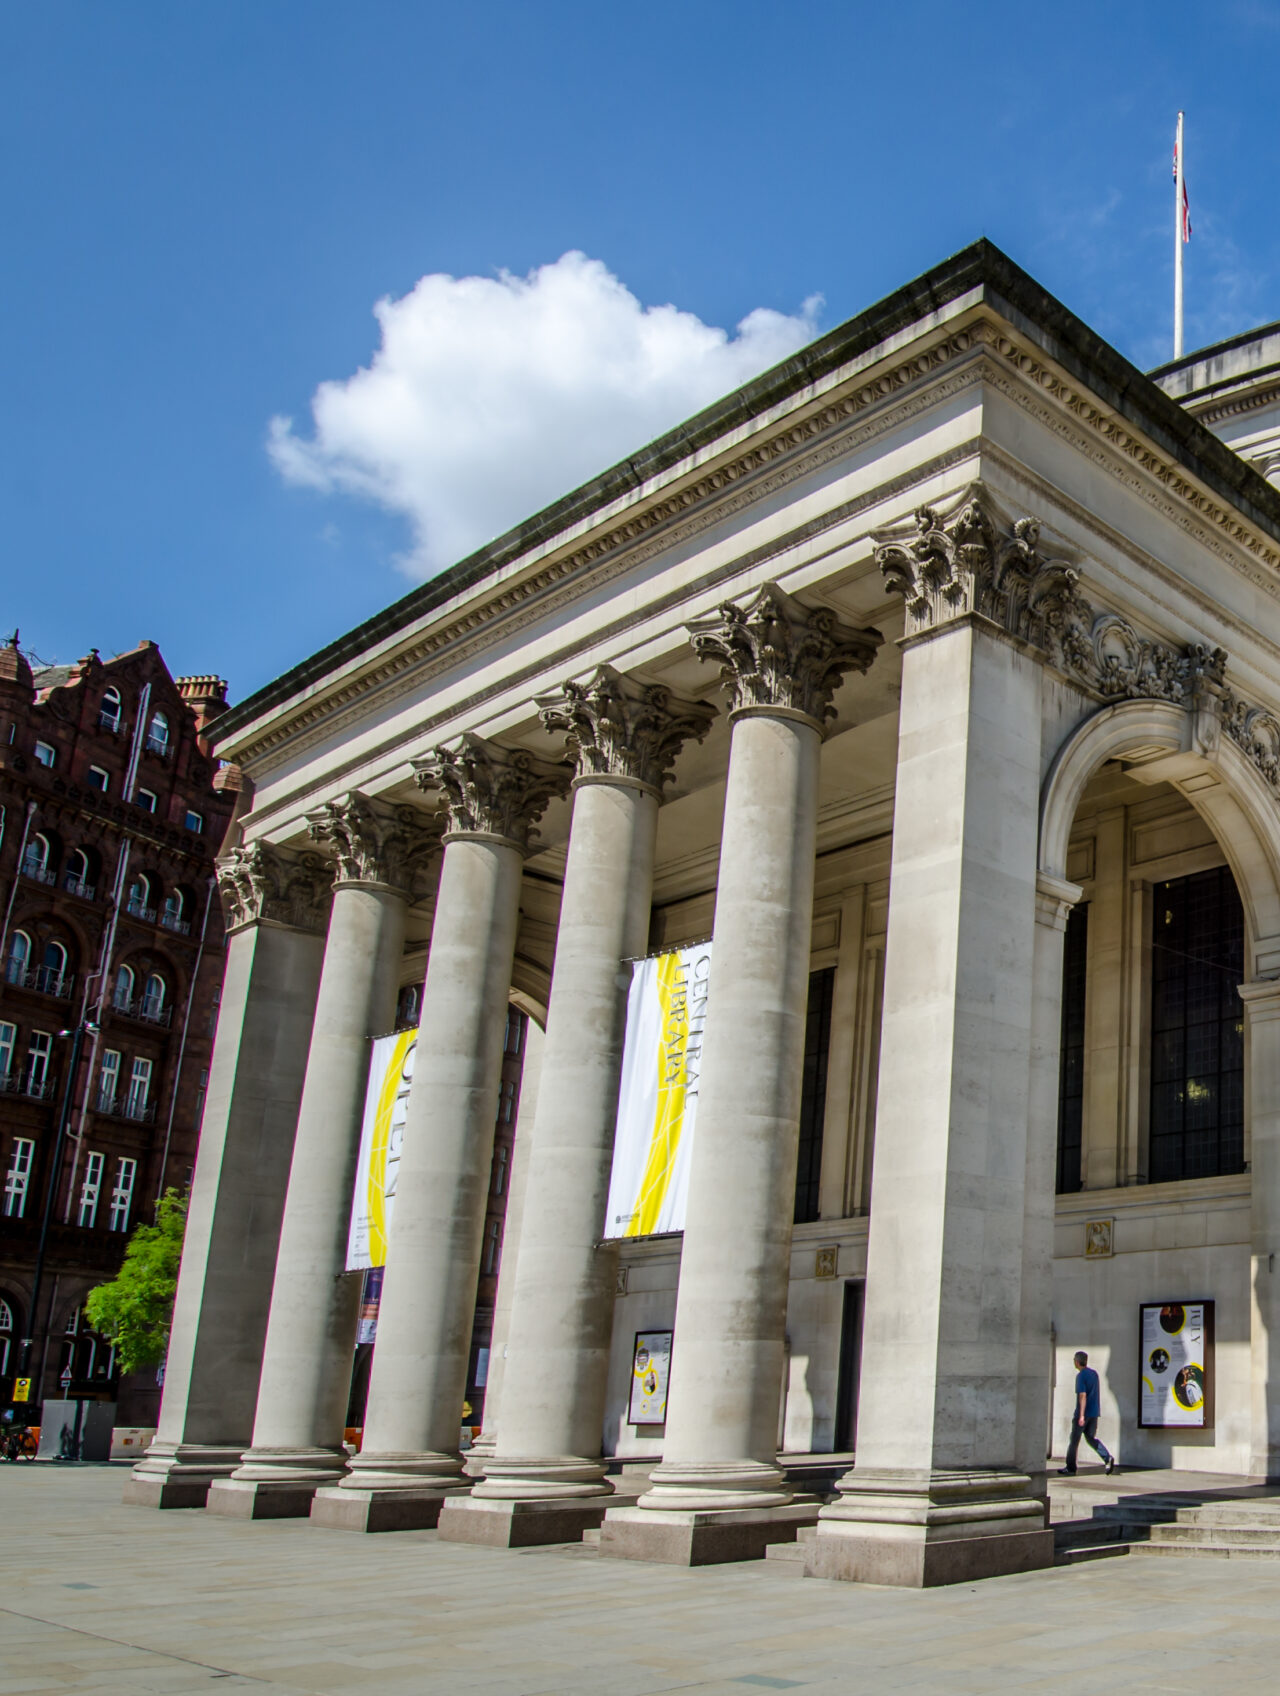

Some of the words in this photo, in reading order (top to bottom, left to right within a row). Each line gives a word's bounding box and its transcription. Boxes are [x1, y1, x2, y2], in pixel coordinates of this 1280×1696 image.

[665, 963, 690, 1085] LIBRARY
[684, 955, 711, 1109] CENTRAL
[1190, 1309, 1201, 1345] JULY
